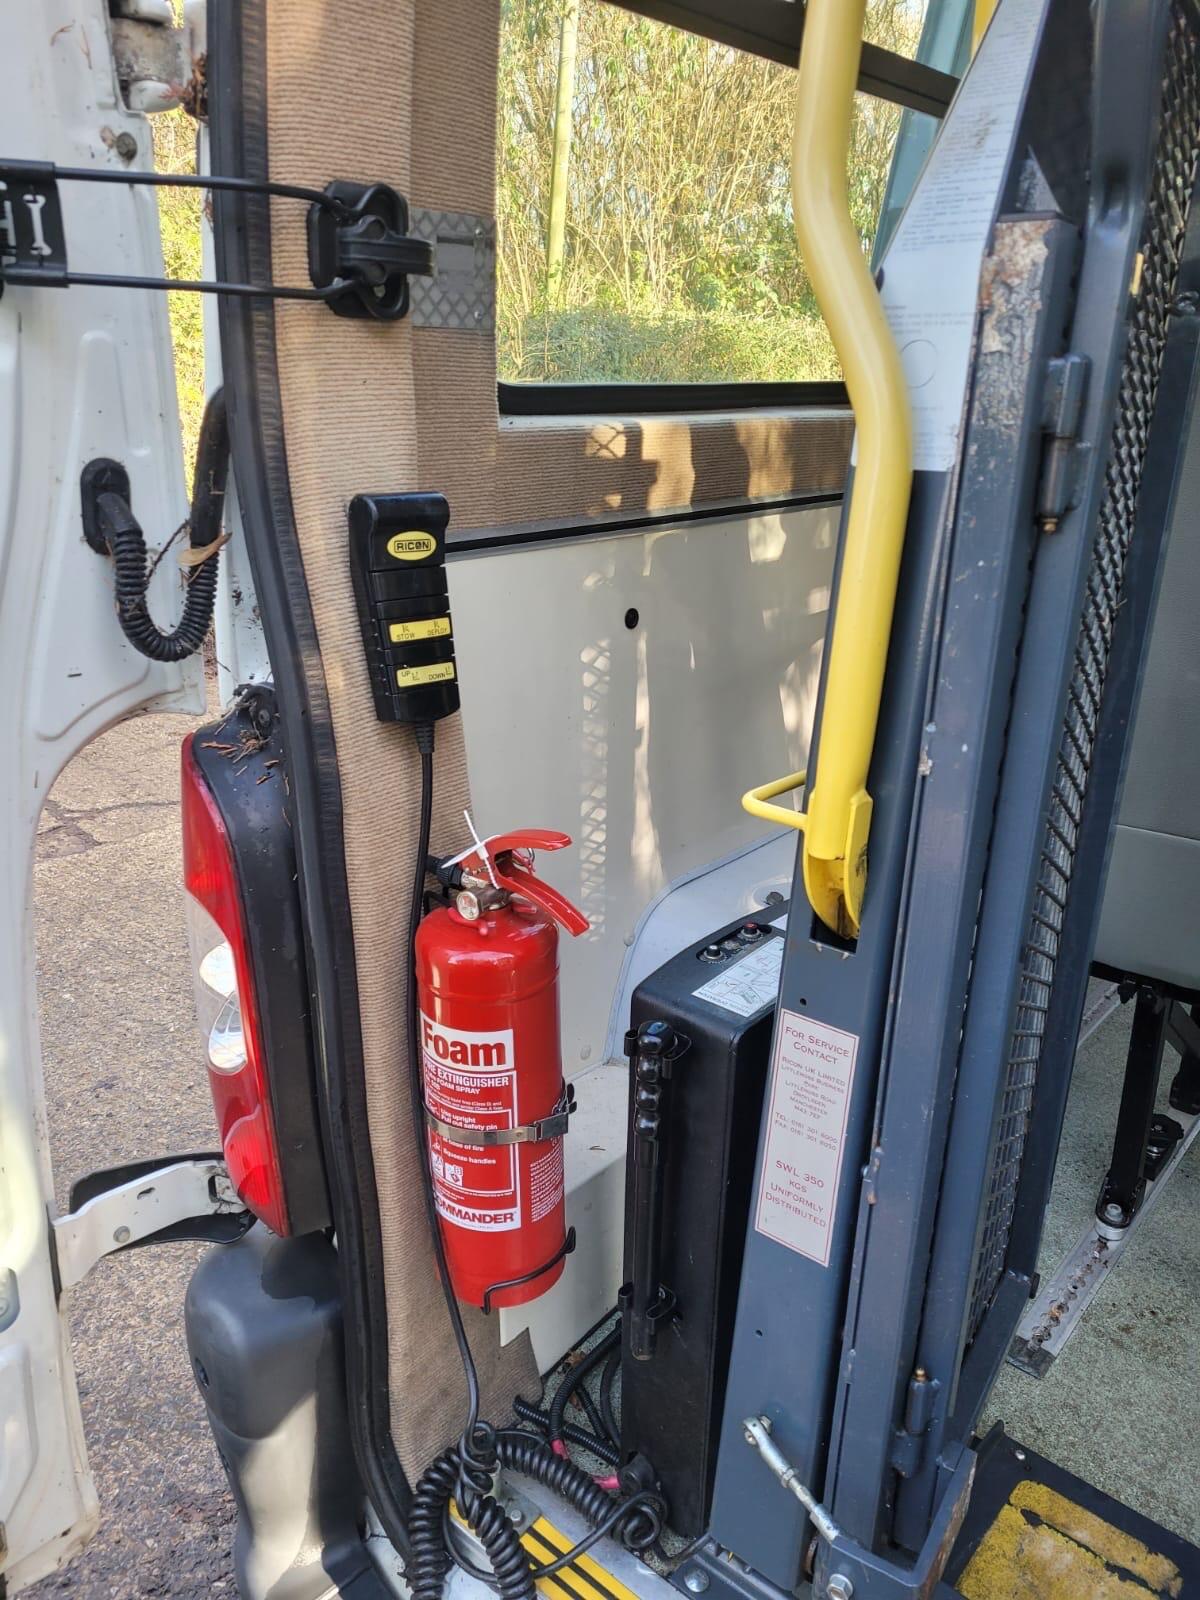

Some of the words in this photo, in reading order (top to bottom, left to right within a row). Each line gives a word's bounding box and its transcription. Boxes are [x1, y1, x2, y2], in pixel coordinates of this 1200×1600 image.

[396, 541, 429, 551] RICON
[396, 632, 415, 640] STOW
[427, 627, 447, 636] DEPLOY
[401, 670, 411, 678] UP
[428, 672, 446, 680] DOWN
[423, 1019, 506, 1067] Foam
[785, 1026, 805, 1040] FOR
[808, 1035, 850, 1058] SERVICE
[793, 1041, 838, 1064] CONTACT
[437, 1067, 509, 1088] EXTINGUISHER
[805, 1065, 816, 1075] UK
[817, 1071, 846, 1087] LIMITED
[437, 1077, 455, 1090] FOAM
[455, 1084, 480, 1095] SPRAY
[440, 1108, 452, 1117] Use
[452, 1114, 476, 1124] upright
[463, 1123, 485, 1131] safety
[443, 1147, 468, 1162] Squeeze
[468, 1157, 497, 1165] handles
[472, 1144, 484, 1152] fire
[775, 1160, 800, 1177] SWL
[802, 1173, 824, 1188] 350
[770, 1181, 824, 1213] UNIFORMLY
[765, 1191, 826, 1228] DISTRIBUTED
